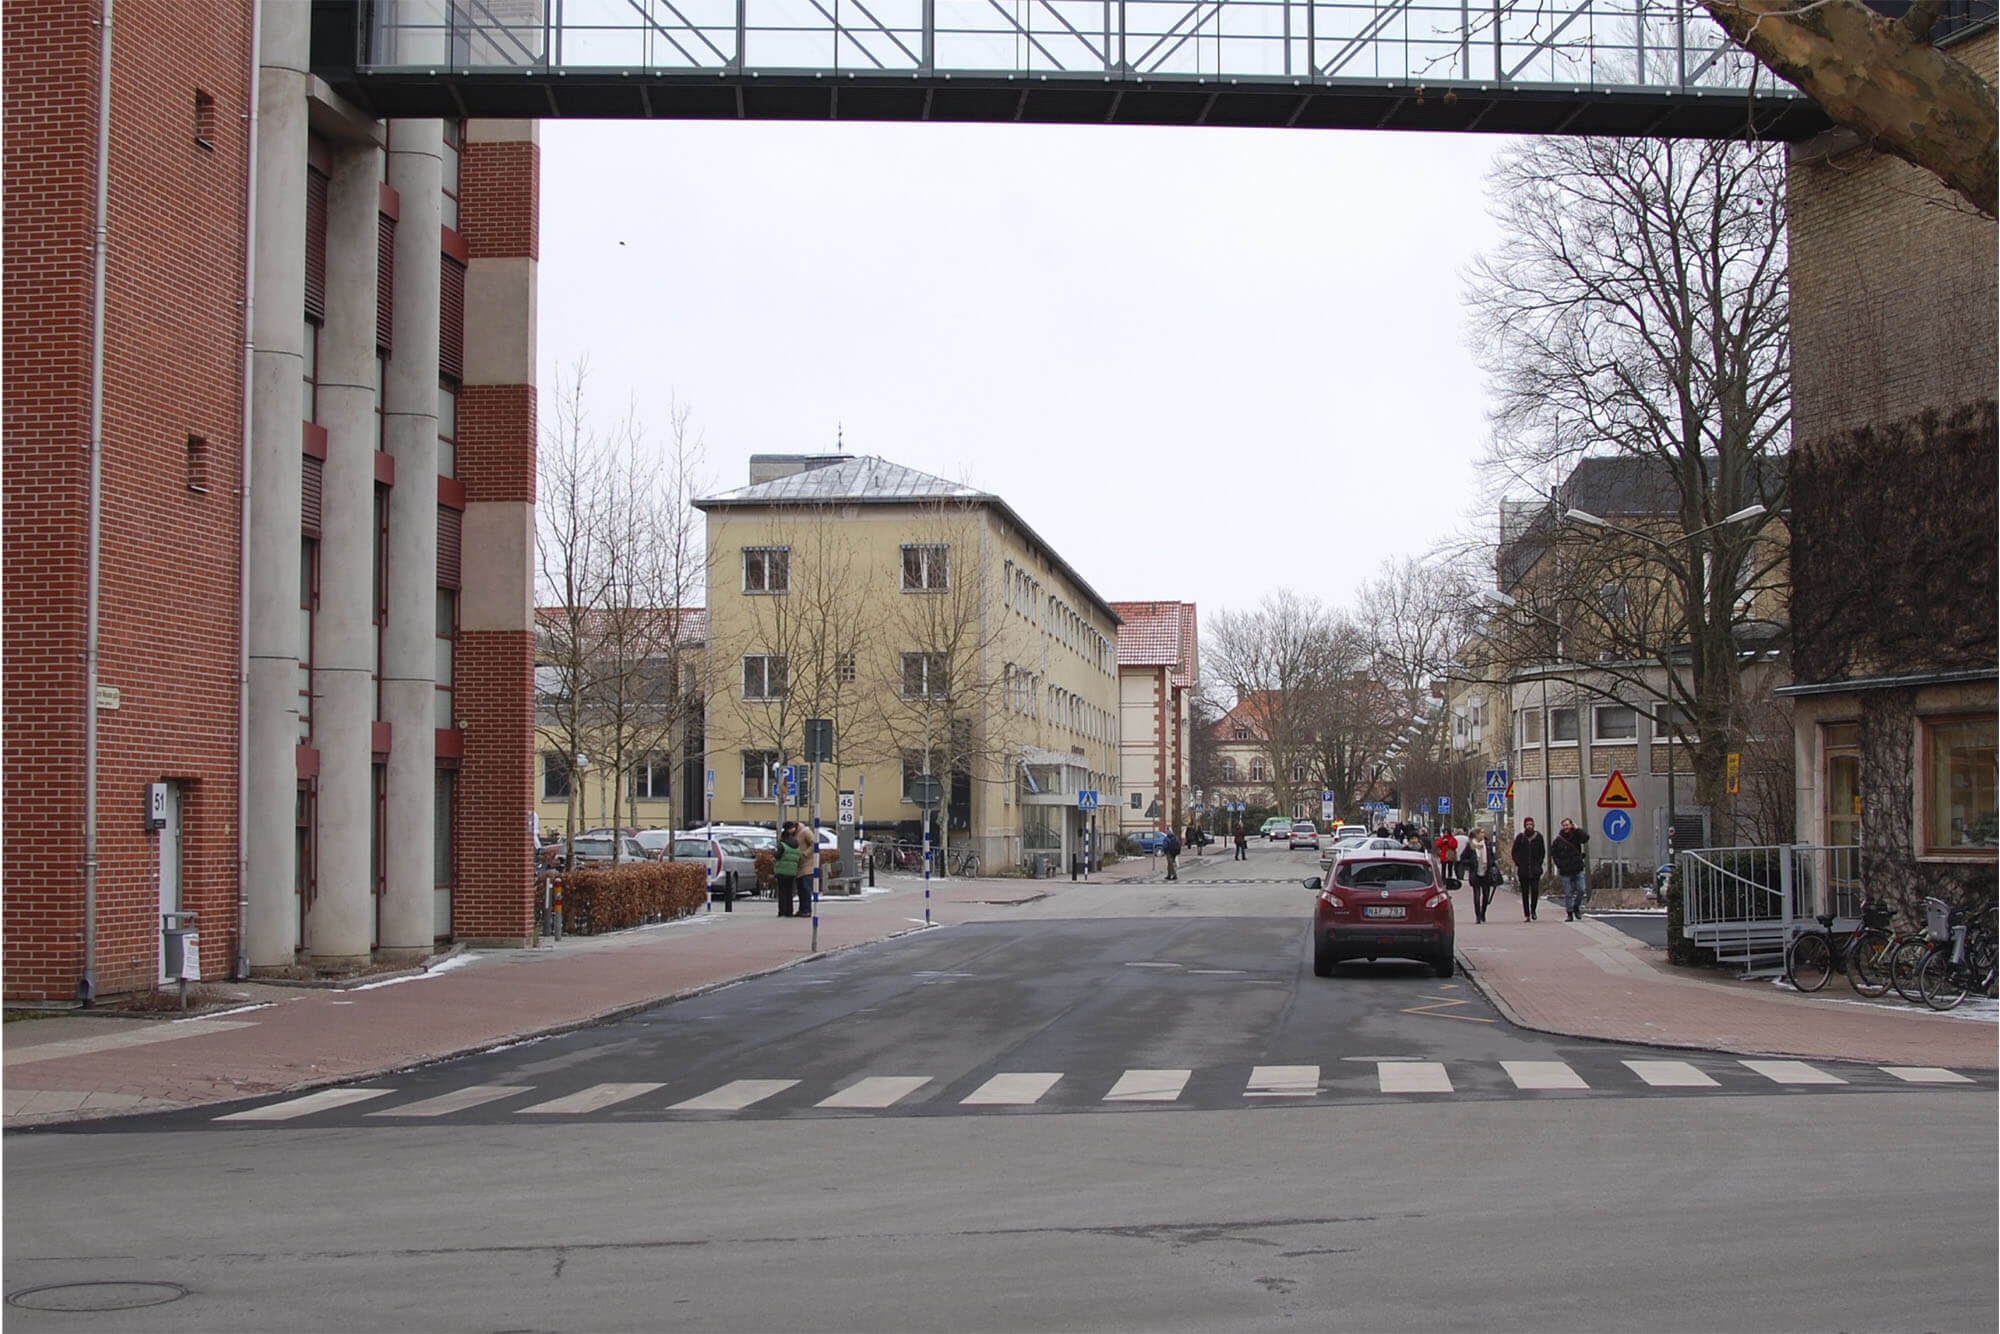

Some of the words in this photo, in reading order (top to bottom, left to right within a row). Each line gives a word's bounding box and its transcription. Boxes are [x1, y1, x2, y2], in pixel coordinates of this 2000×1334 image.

[155, 793, 164, 811] 51
[841, 799, 852, 807] 45
[841, 814, 852, 822] 49
